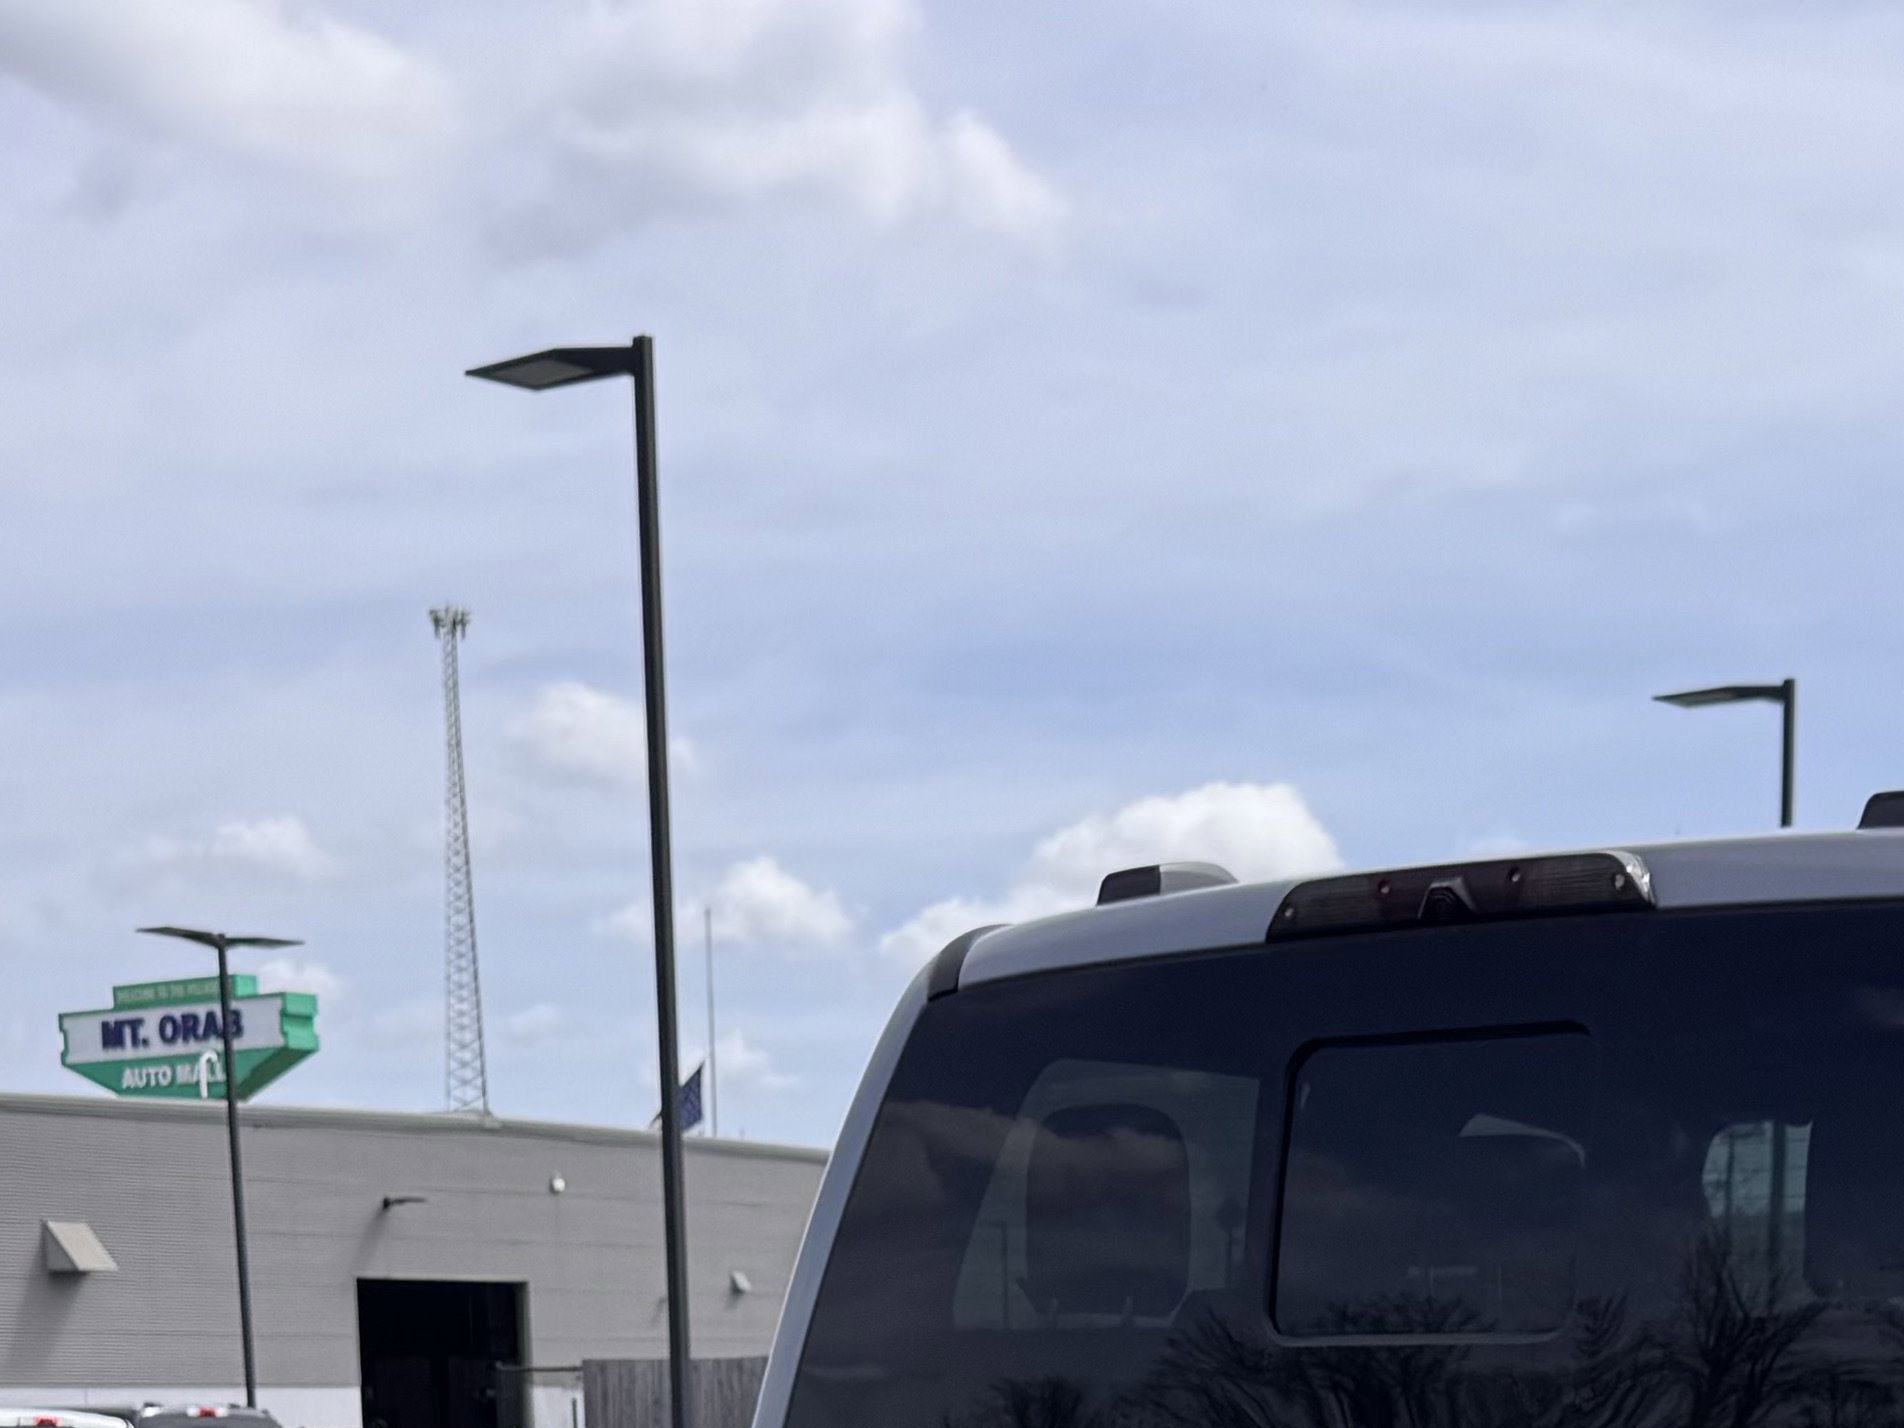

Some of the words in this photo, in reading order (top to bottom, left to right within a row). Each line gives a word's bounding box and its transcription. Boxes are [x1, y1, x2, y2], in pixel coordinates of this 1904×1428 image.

[101, 1018, 149, 1050] MT.
[158, 1009, 243, 1044] ORAB
[122, 1064, 172, 1089] AUTO
